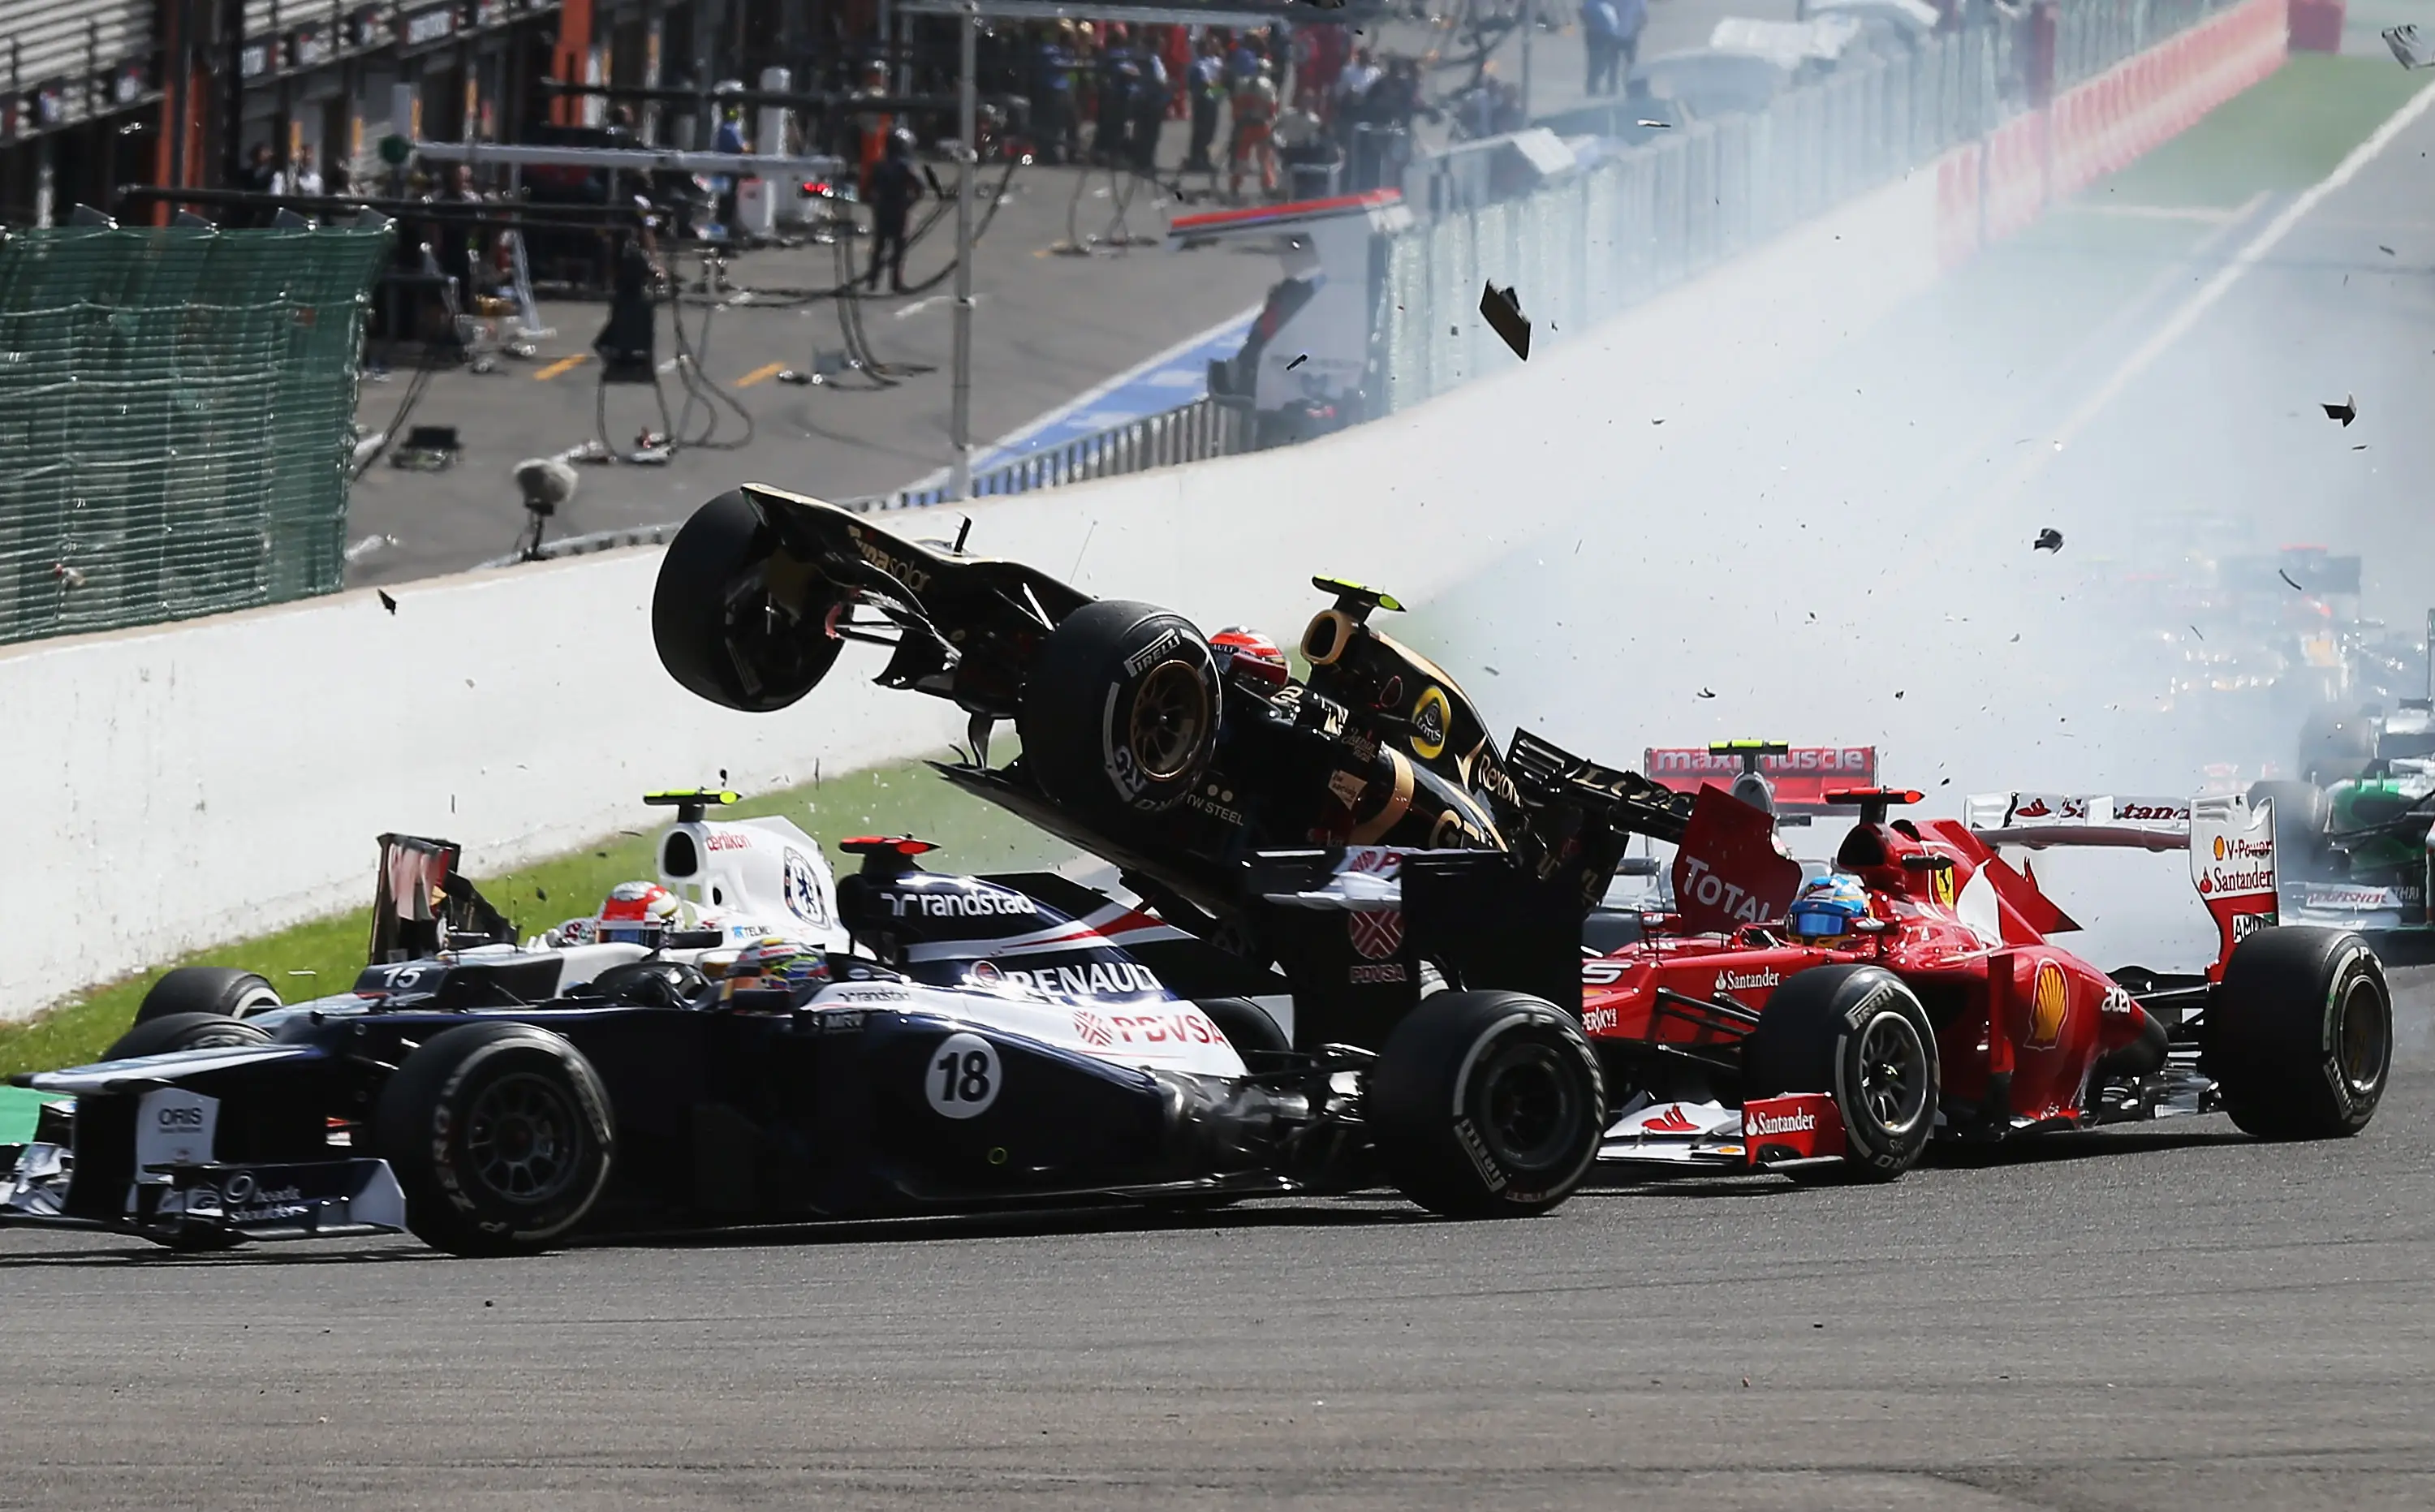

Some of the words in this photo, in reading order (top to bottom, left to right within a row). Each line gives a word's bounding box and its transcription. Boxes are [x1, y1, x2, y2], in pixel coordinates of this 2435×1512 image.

[1123, 628, 1181, 678] PIRELLI
[1477, 753, 1521, 808] Rexon
[1205, 802, 1244, 827] STEEL
[2213, 860, 2273, 893] Santander
[920, 890, 1037, 917] randstad
[743, 926, 773, 937] TELME
[383, 967, 428, 989] 15
[1004, 961, 1166, 999] RENAULT
[1726, 966, 1780, 990] Santander
[1581, 1006, 1612, 1033] PERSKY
[1844, 980, 1894, 1031] PIRELLI
[1110, 1014, 1231, 1050] PDVSA
[937, 1049, 991, 1104] 18
[1758, 1106, 1815, 1135] Santander
